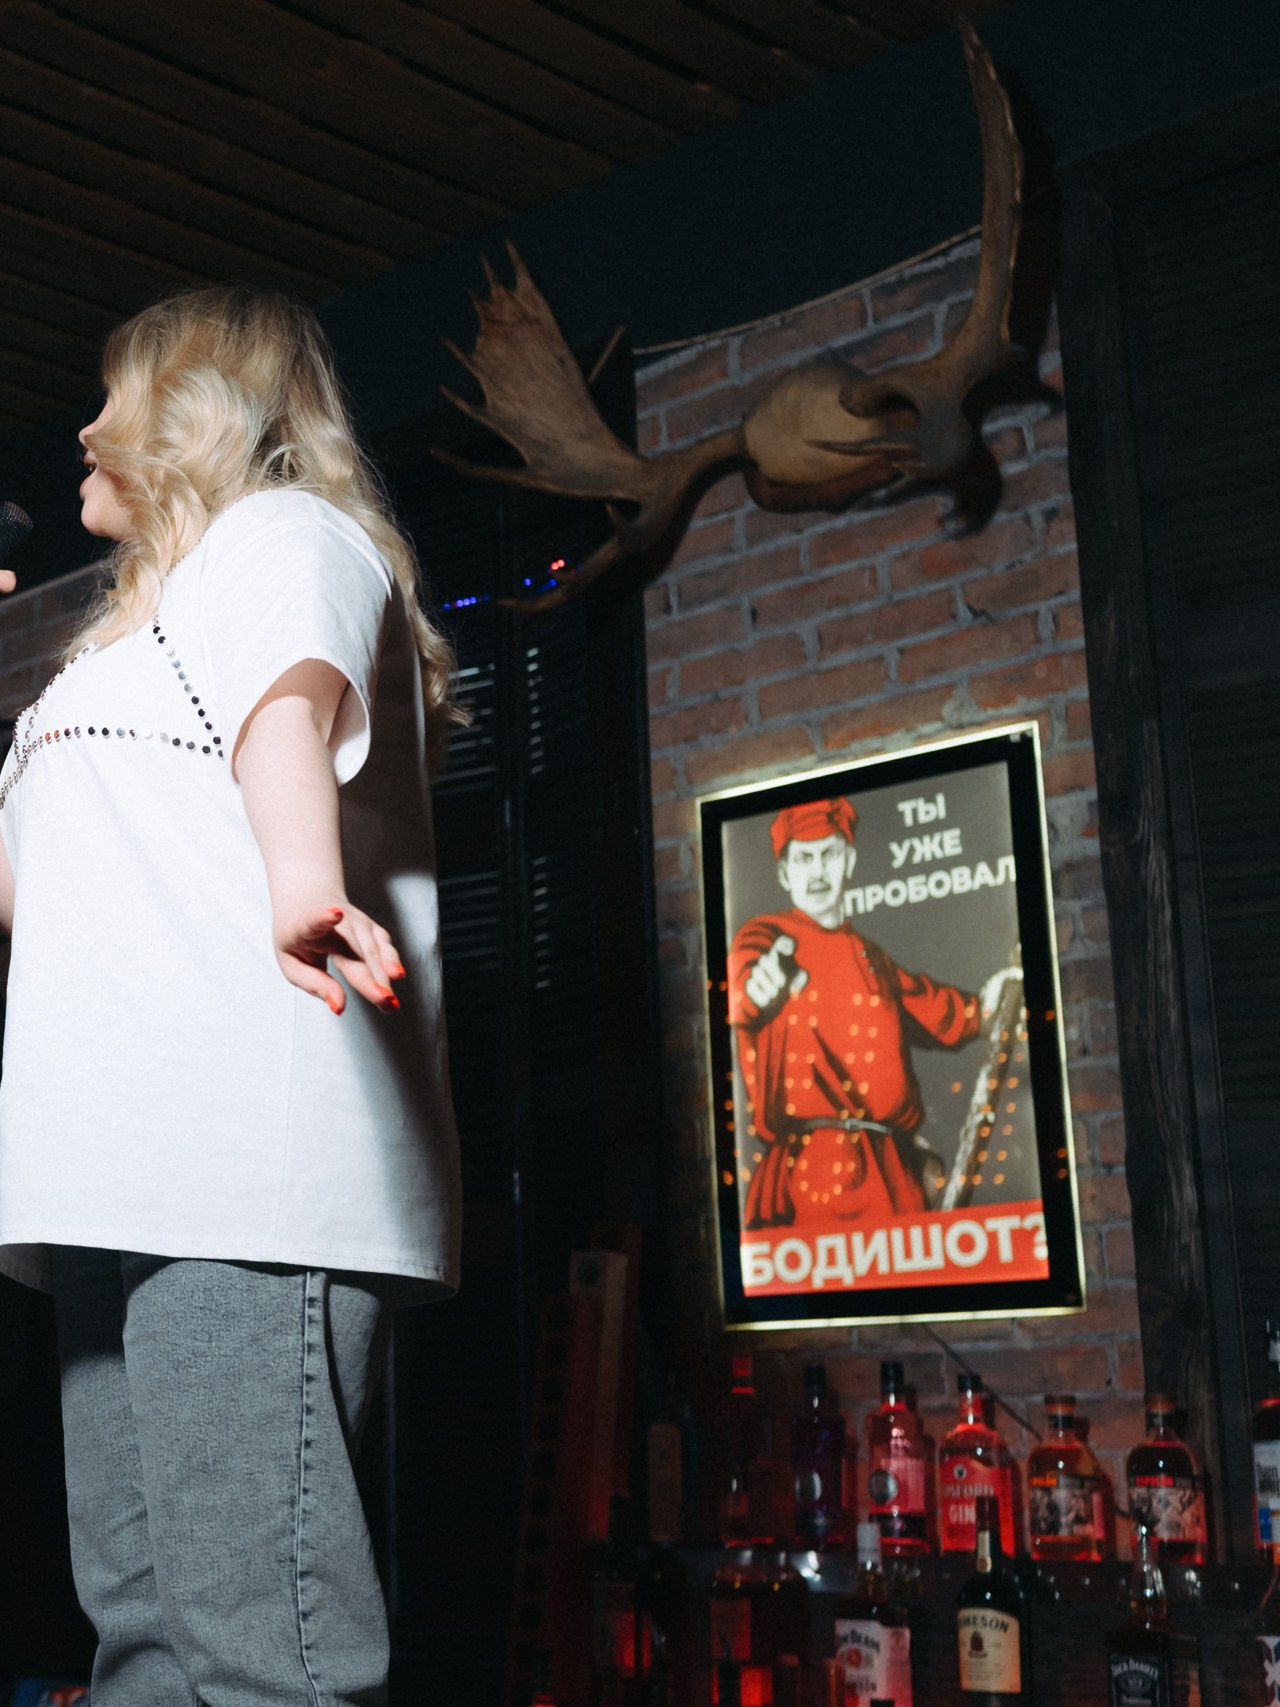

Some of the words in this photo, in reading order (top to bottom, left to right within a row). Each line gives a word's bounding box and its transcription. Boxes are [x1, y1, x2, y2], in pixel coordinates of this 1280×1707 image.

[897, 793, 947, 828] ТЫ
[889, 829, 963, 869] УЖЕ
[844, 855, 1016, 917] ПРОБОВАЛ
[739, 1212, 1049, 1289] БОДИШОТ?
